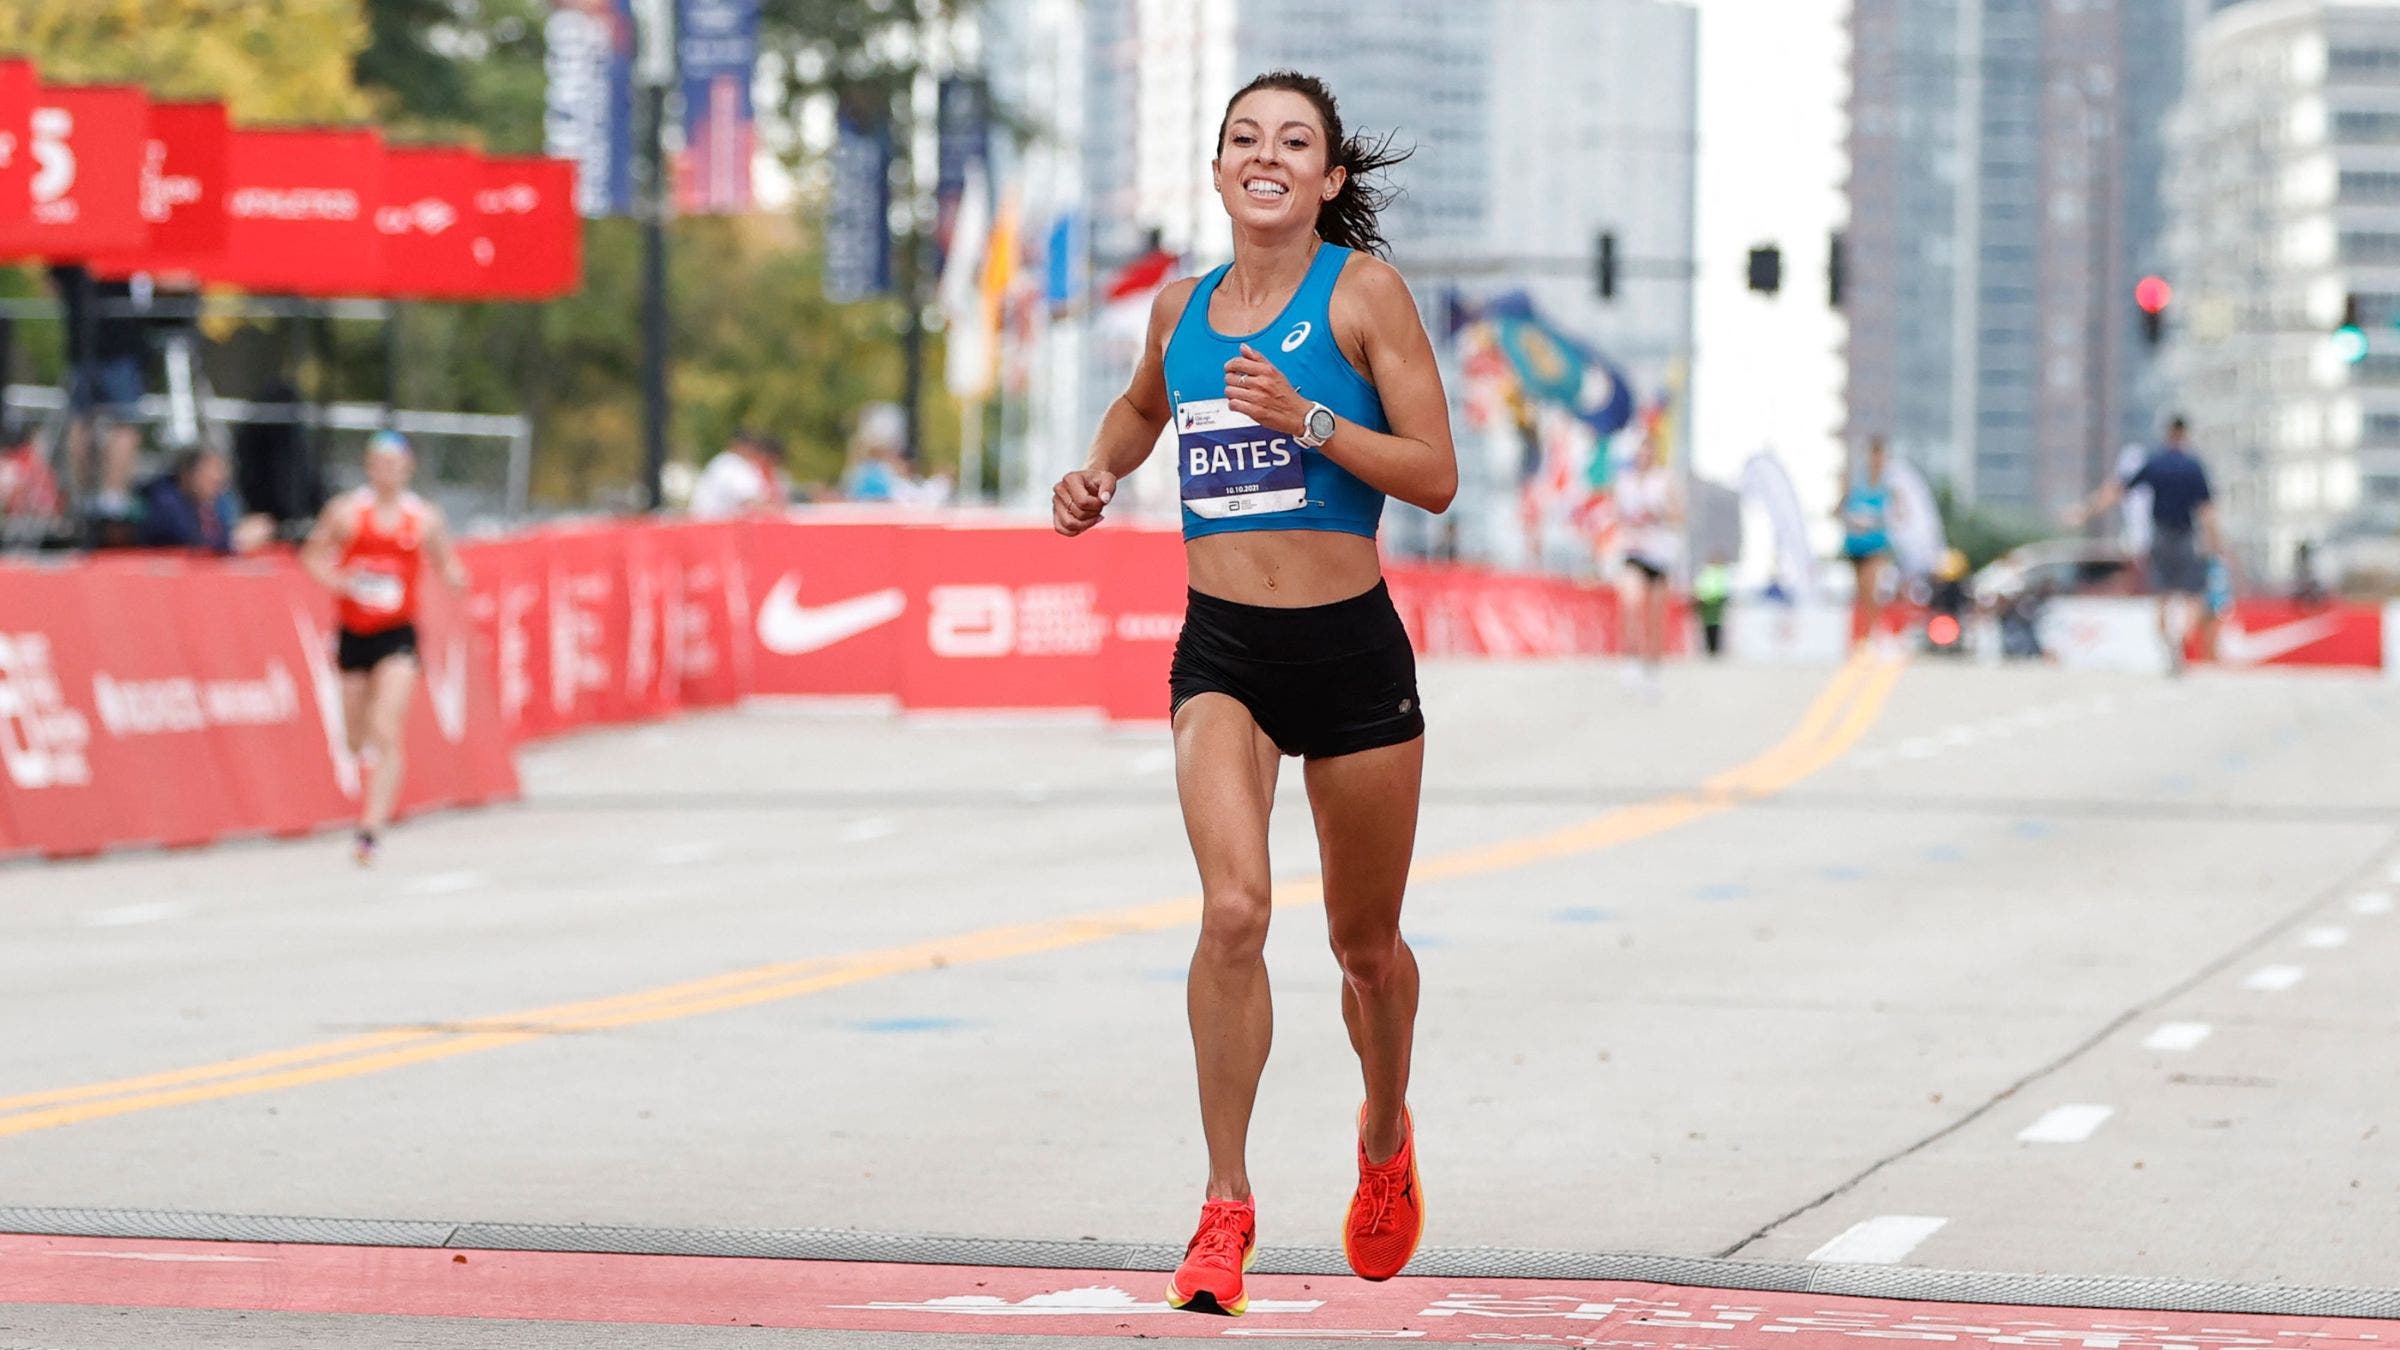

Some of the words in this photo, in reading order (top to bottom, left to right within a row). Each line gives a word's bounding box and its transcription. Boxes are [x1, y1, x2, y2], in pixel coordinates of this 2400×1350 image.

[1189, 438, 1291, 476] BATES
[1226, 484, 1259, 494] 10.10.2021
[1429, 1300, 2275, 1344] Chicago
